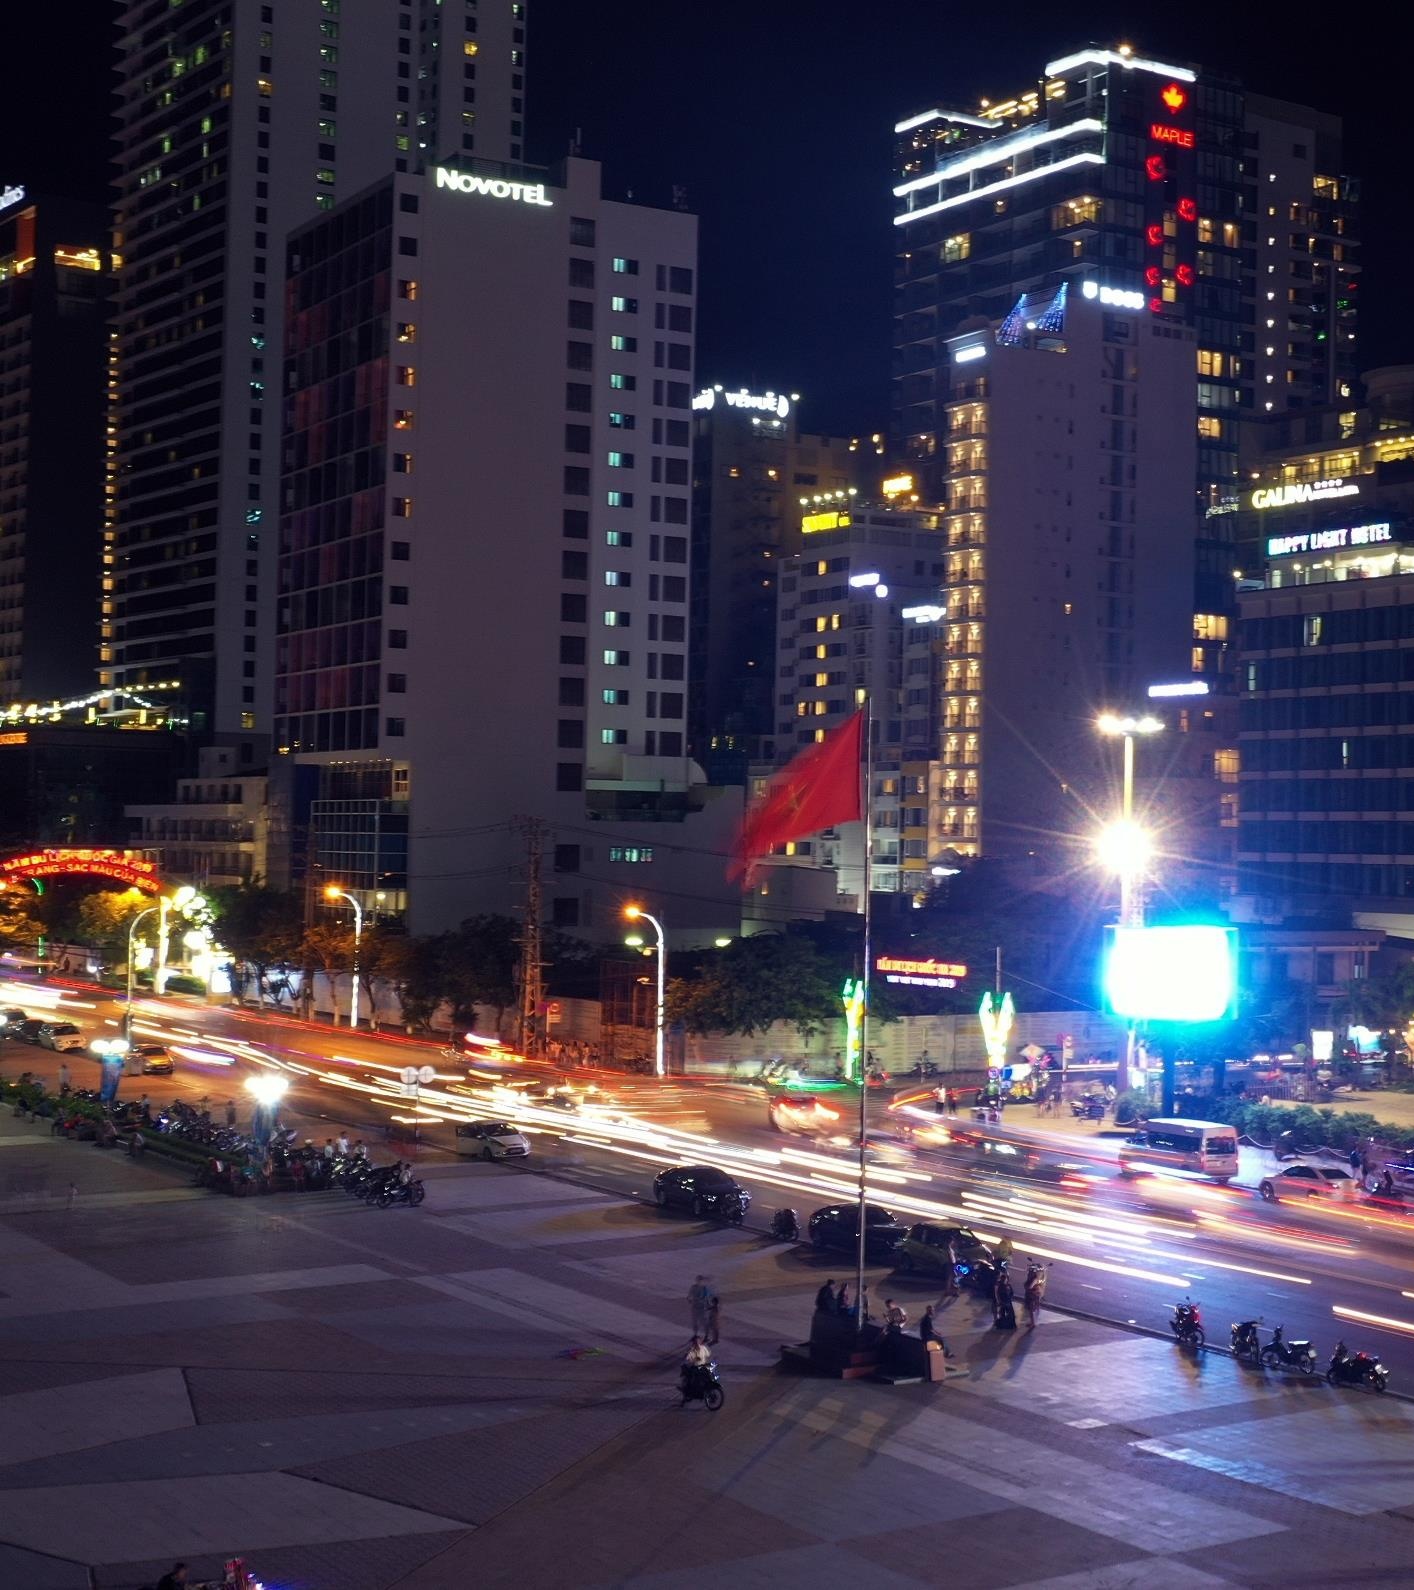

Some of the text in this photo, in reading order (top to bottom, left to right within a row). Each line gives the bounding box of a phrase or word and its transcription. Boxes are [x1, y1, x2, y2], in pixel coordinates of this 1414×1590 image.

[1151, 125, 1194, 147] MAPLE
[436, 167, 554, 206] NOVOTEL
[1251, 483, 1313, 509] GALINA
[1268, 534, 1309, 556] HAPPY
